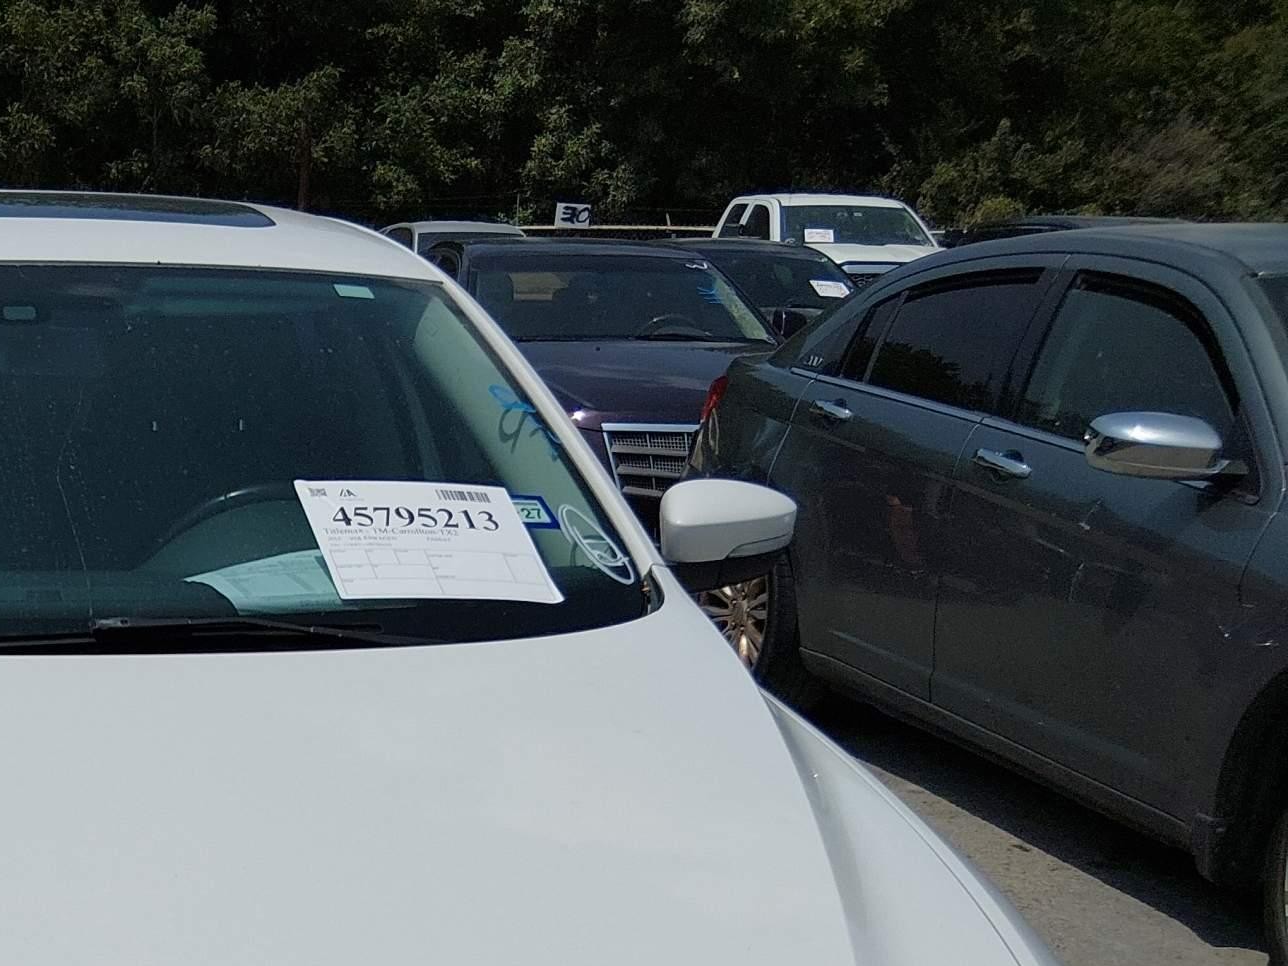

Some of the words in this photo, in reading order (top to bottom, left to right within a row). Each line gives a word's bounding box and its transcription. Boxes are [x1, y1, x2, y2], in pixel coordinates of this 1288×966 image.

[560, 206, 590, 224] 30
[331, 505, 500, 532] 45795213
[520, 507, 542, 520] 27
